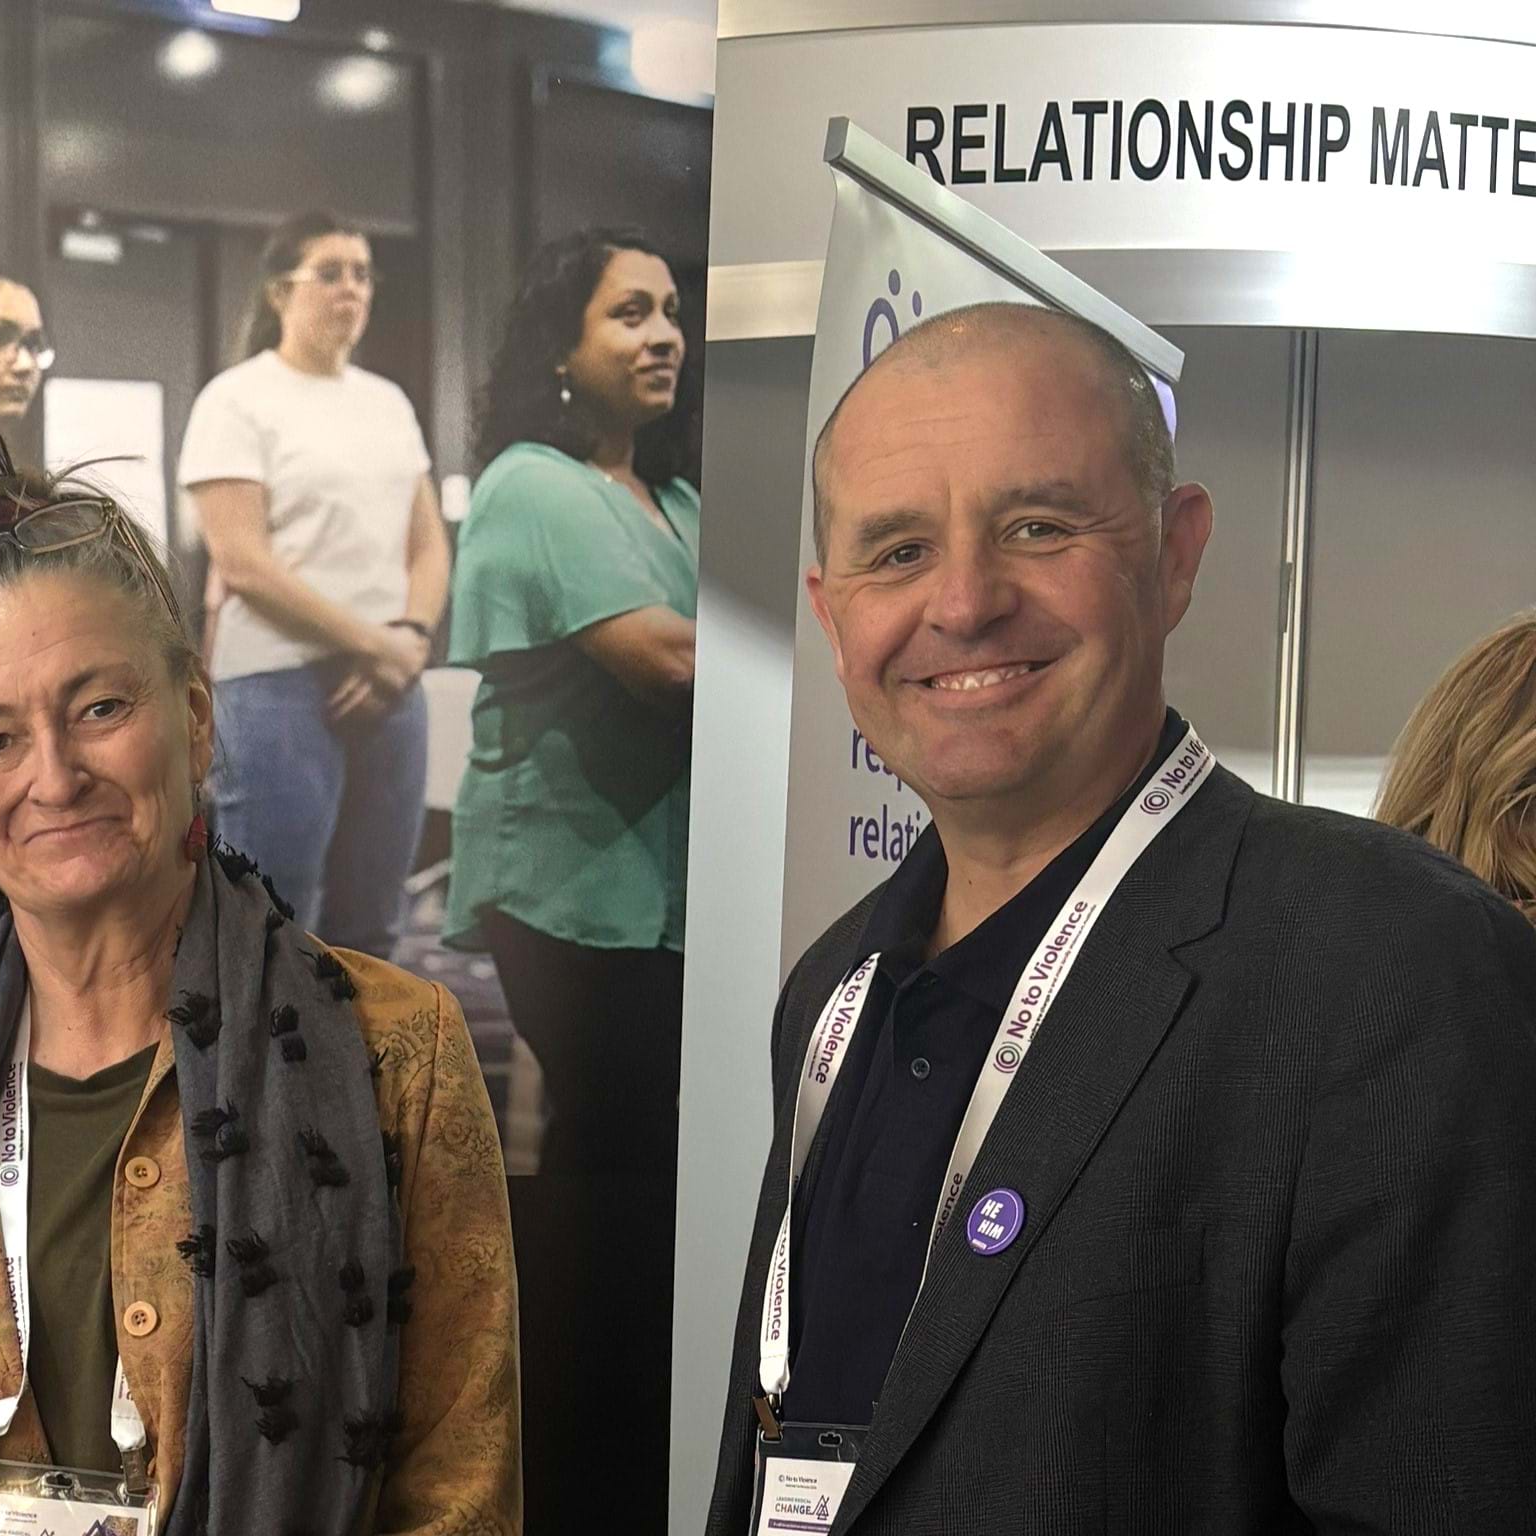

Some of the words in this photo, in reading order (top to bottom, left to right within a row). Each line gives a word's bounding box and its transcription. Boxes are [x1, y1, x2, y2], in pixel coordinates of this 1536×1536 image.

[906, 99, 1351, 186] RELATIONSHIP
[1028, 900, 1089, 982] Violence
[844, 984, 862, 1003] to
[1021, 985, 1042, 1007] to
[1006, 1009, 1032, 1039] No
[815, 1006, 856, 1084] Violence
[2, 1062, 17, 1126] Violence
[2, 1126, 17, 1141] to
[1, 1143, 17, 1162] No
[980, 1198, 1004, 1219] HE
[976, 1218, 1005, 1240] HIM
[774, 1503, 812, 1515] CHANGE
